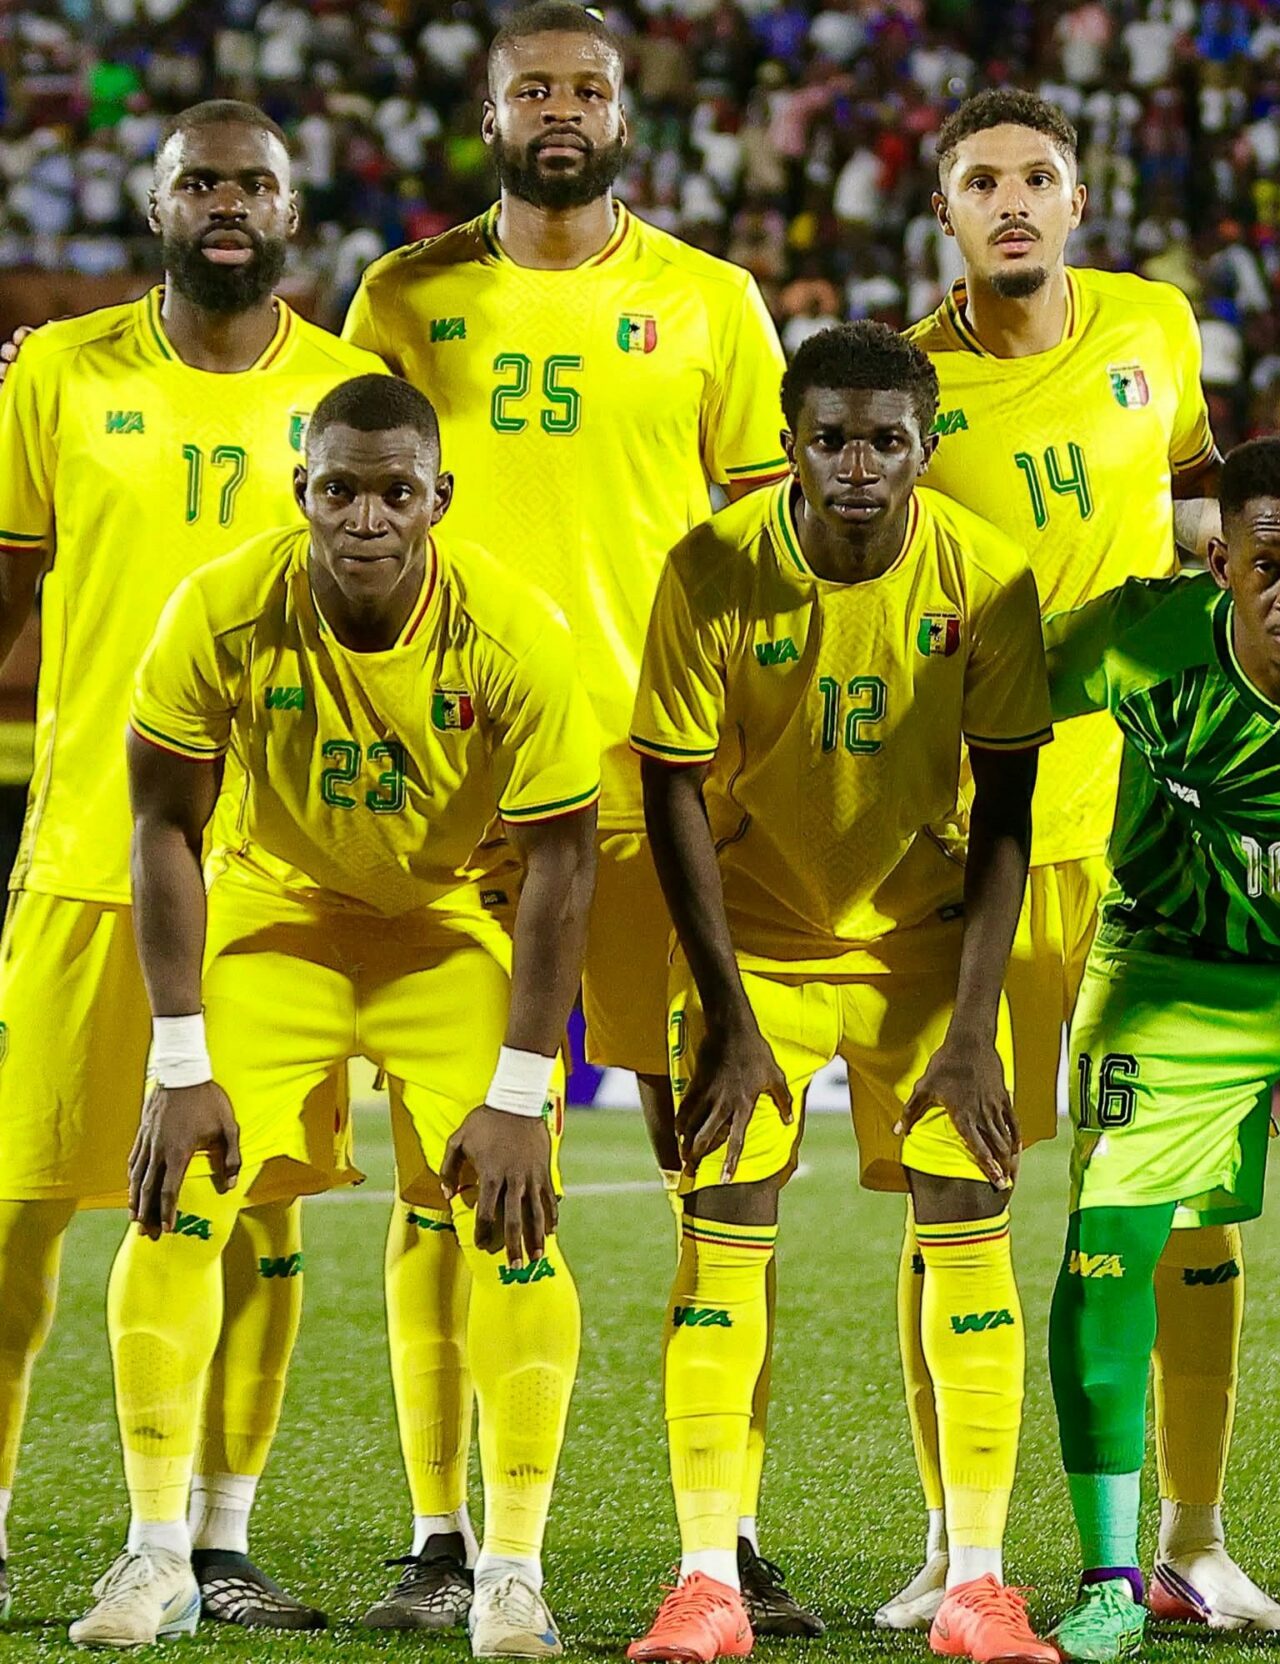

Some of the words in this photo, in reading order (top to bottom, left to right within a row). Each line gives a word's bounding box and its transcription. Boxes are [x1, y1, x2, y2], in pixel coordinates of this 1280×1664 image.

[430, 317, 467, 343] WA
[491, 353, 584, 436] 25
[105, 411, 145, 435] WA
[183, 445, 247, 528] 17
[1014, 442, 1093, 531] 14
[755, 637, 800, 667] WA
[265, 686, 305, 711] WA
[819, 675, 887, 757] 12
[320, 739, 408, 815] 23
[1165, 777, 1201, 808] WA
[1077, 1053, 1140, 1131] 16
[499, 1257, 556, 1285] WA
[1069, 1250, 1128, 1279] WA
[1182, 1259, 1240, 1286] WA
[674, 1306, 734, 1328] WA
[950, 1309, 1014, 1334] WA
